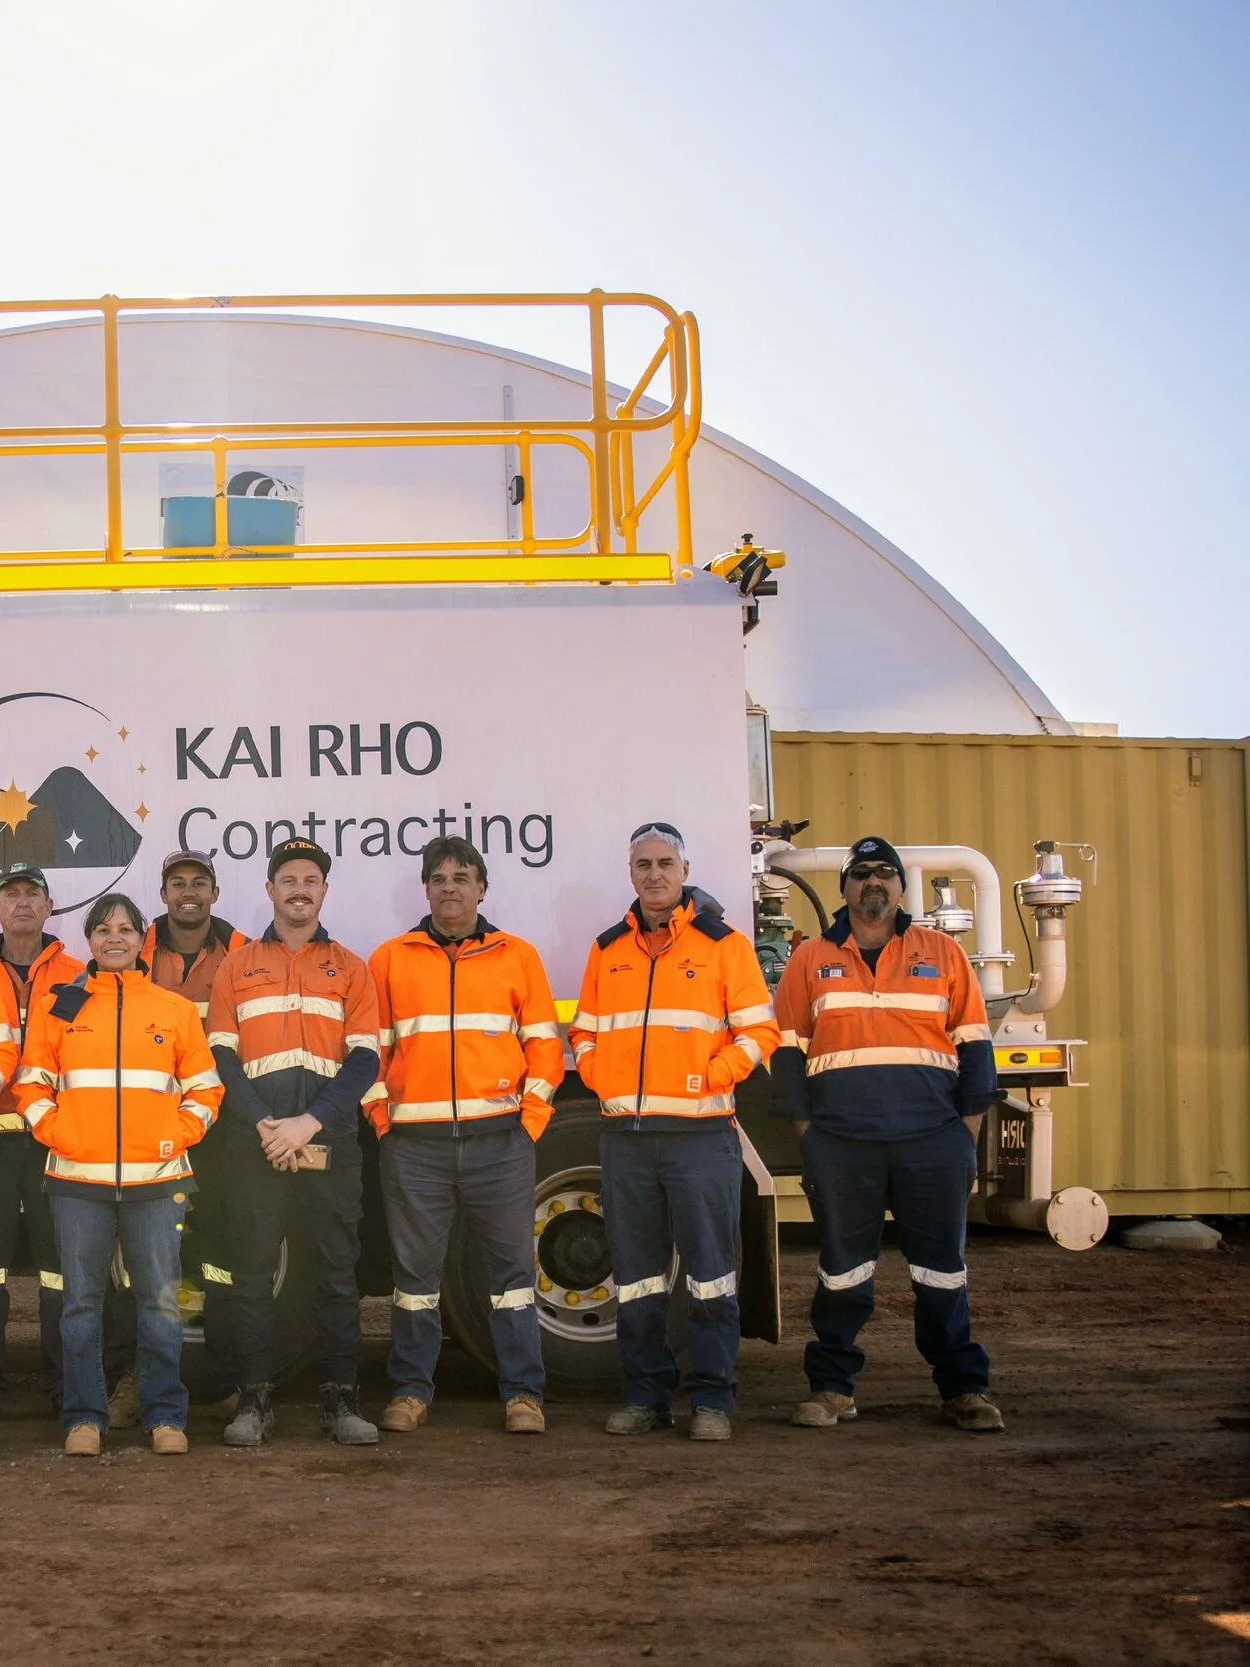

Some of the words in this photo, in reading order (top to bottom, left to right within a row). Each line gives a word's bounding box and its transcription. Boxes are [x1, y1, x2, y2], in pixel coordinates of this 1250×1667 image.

[175, 726, 282, 780] KAI
[309, 721, 442, 776] RHO
[178, 802, 553, 868] Contracting
